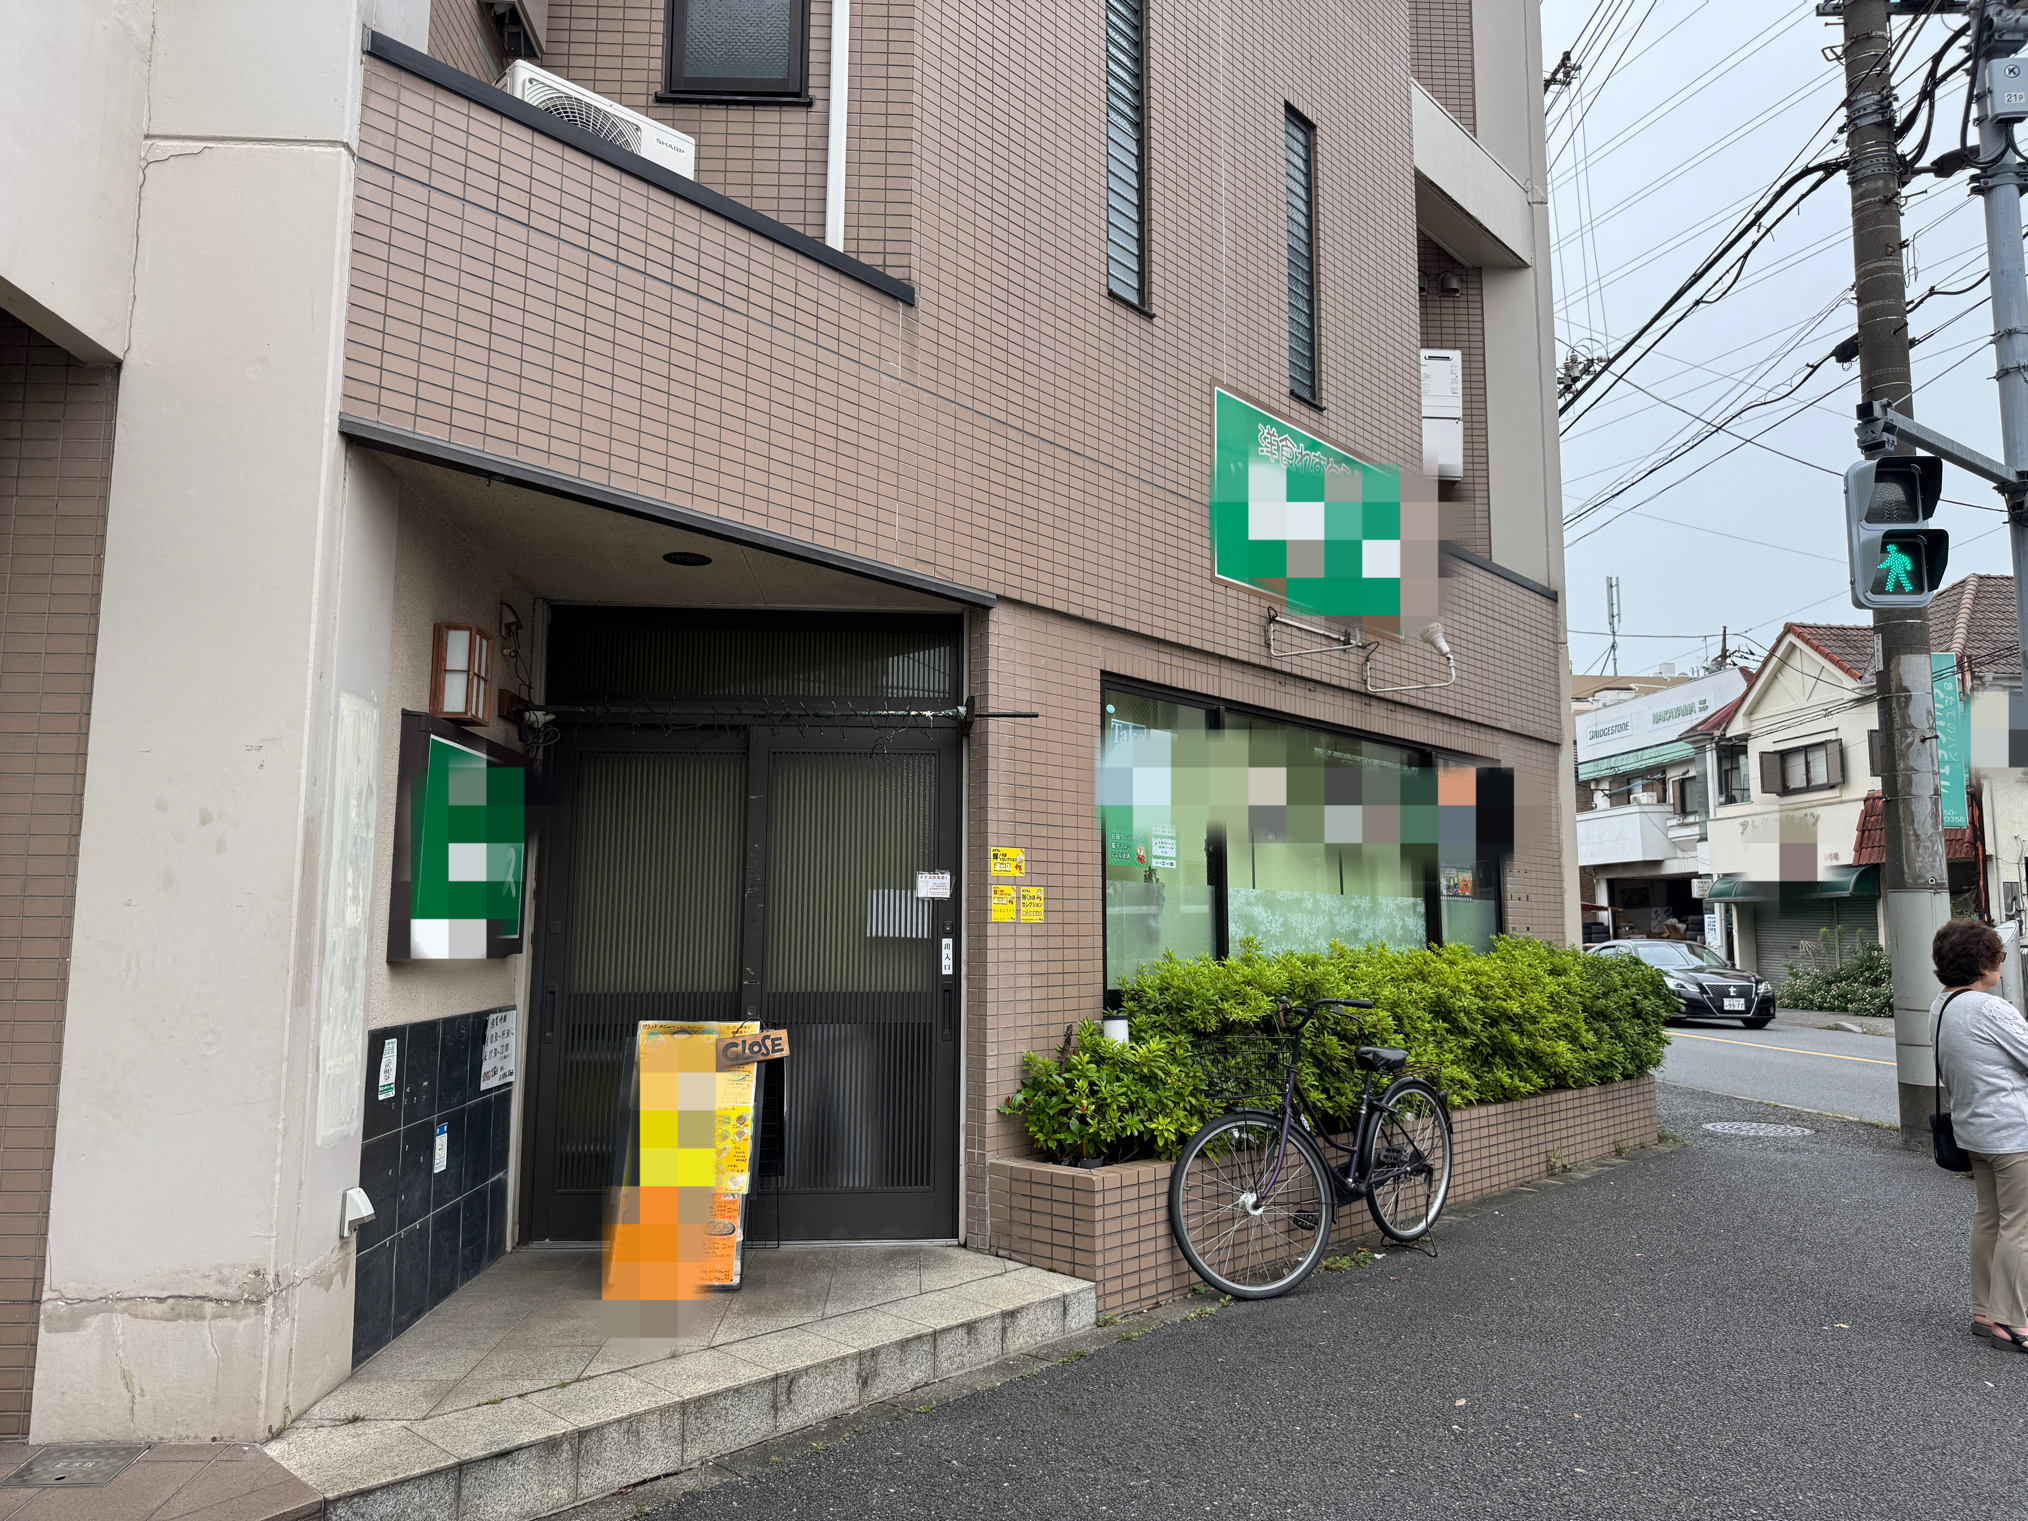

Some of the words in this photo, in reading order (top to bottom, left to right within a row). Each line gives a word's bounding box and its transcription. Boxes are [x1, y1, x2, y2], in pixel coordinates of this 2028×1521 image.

[656, 138, 685, 154] SHARP
[1652, 702, 1697, 725] NAKAYAMA
[1588, 721, 1630, 741] BRIDGESTONE
[721, 1034, 785, 1063] CLOSE
